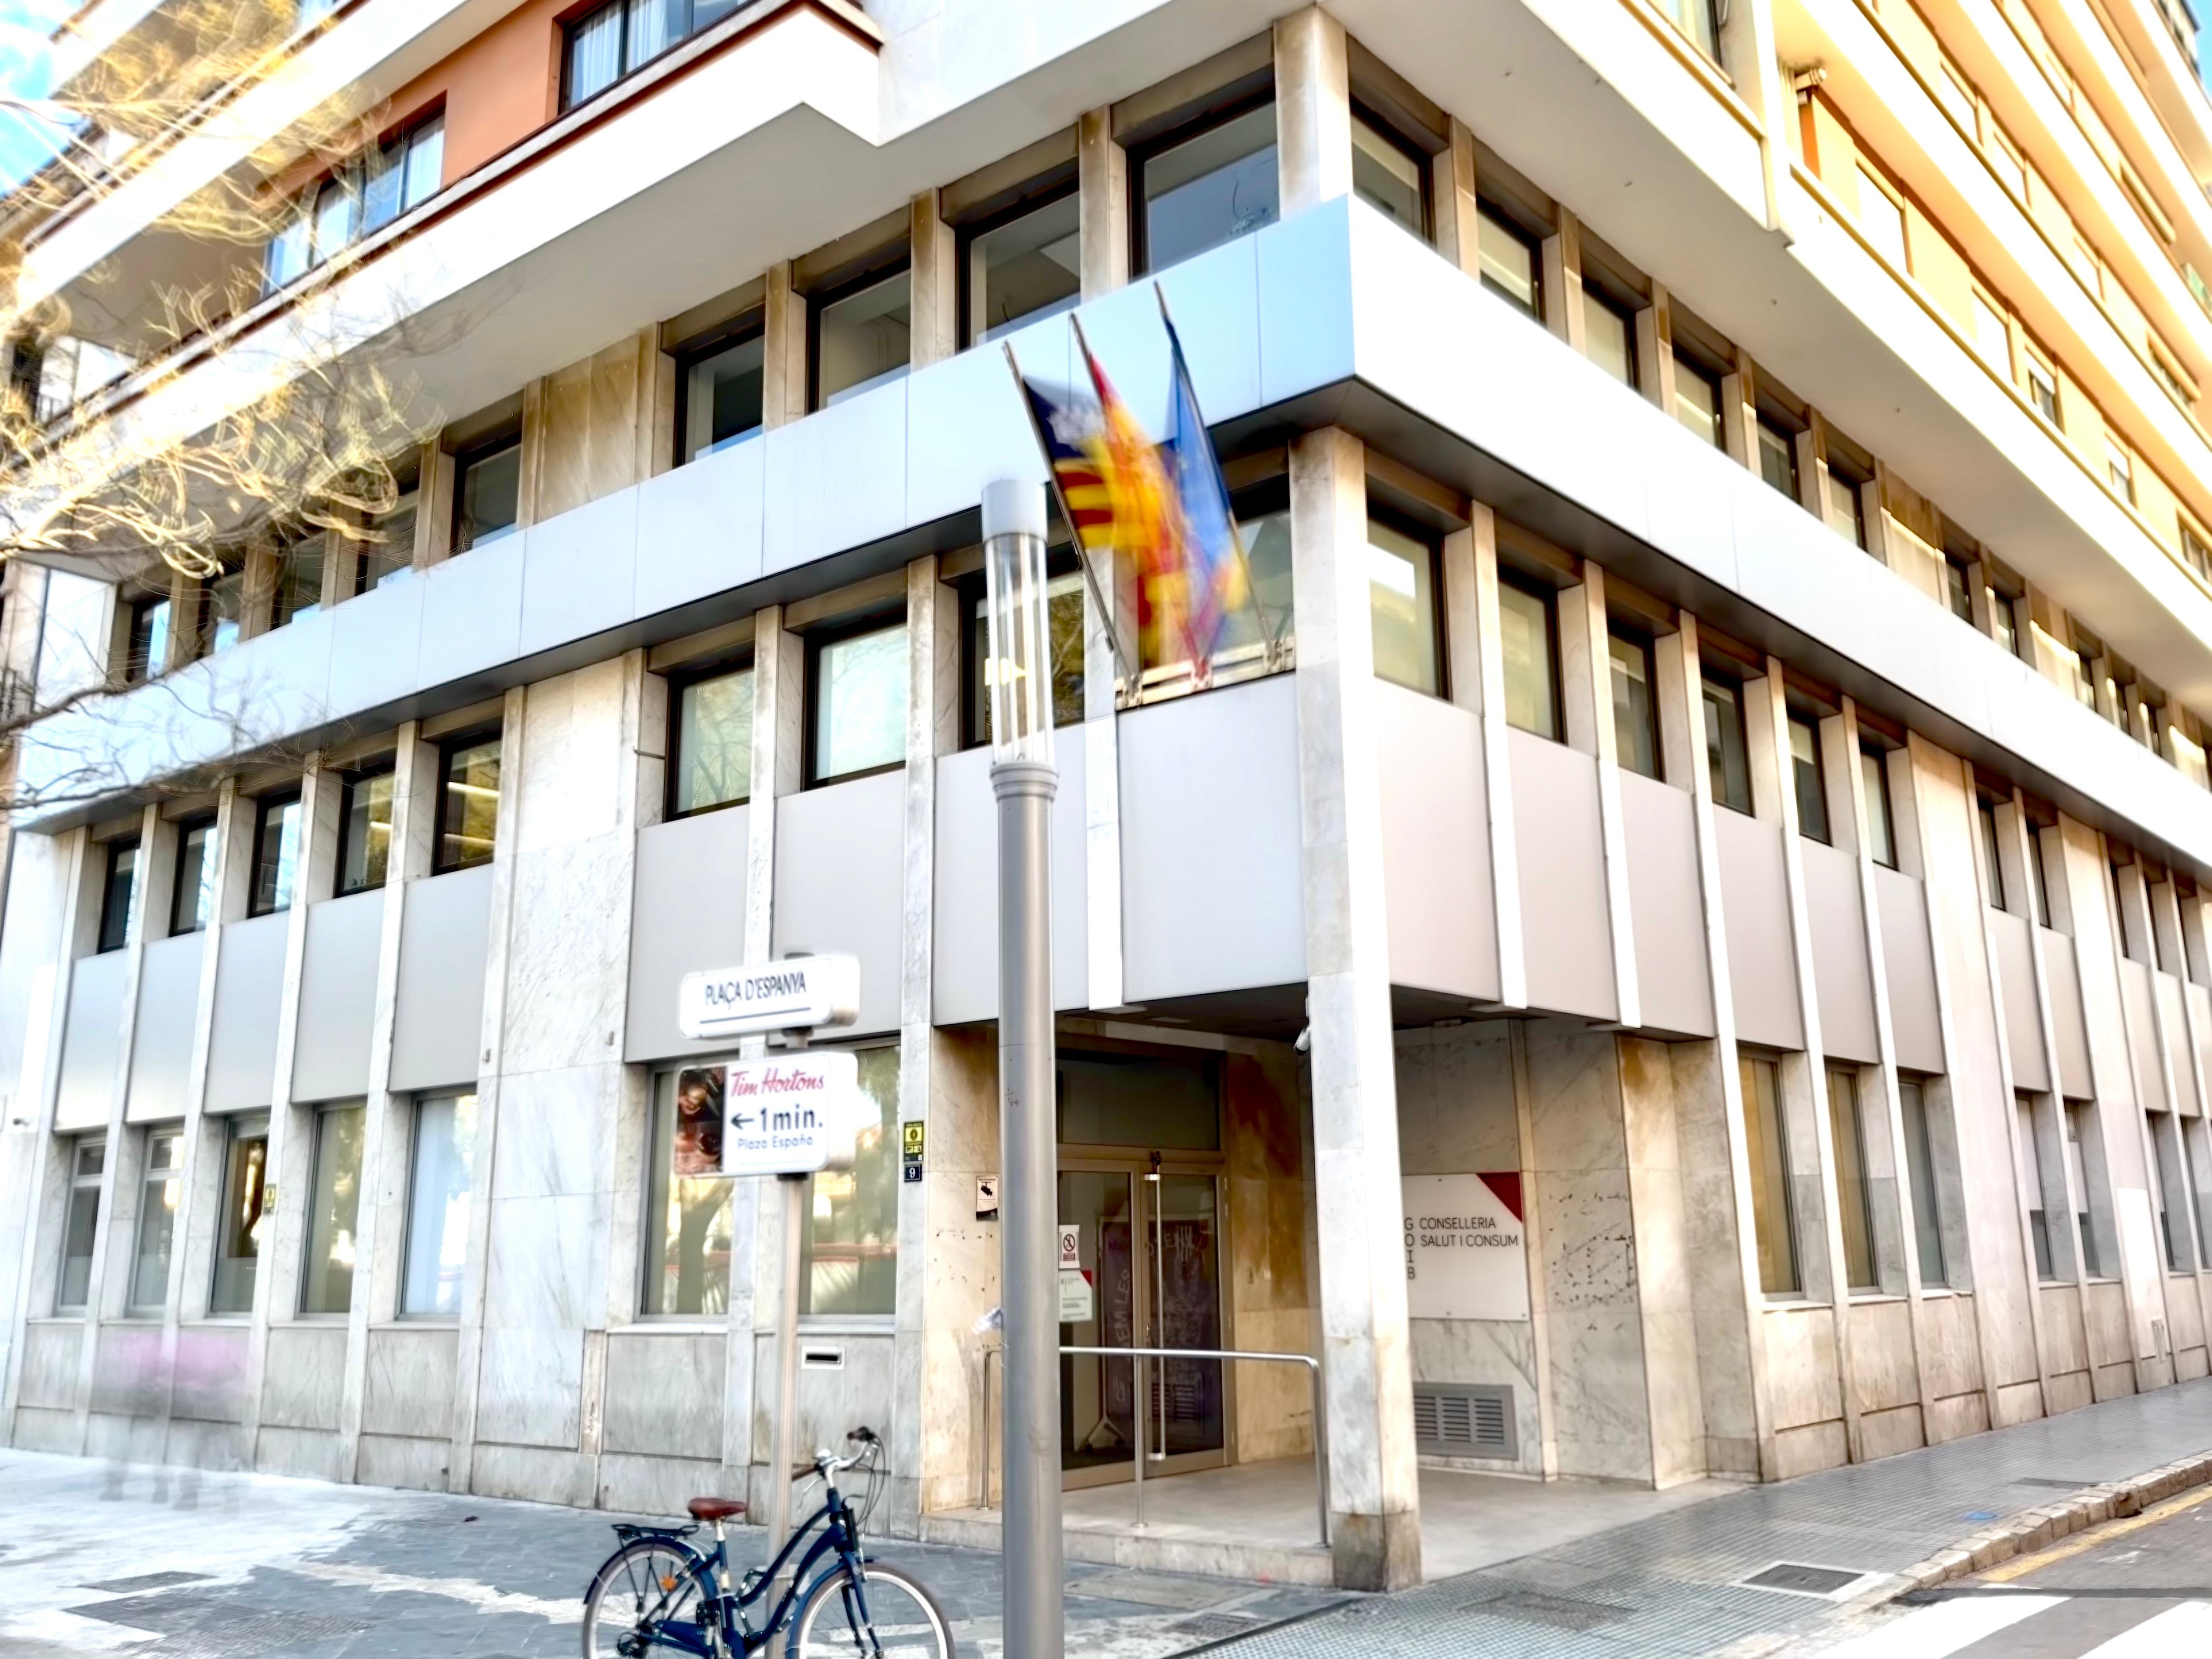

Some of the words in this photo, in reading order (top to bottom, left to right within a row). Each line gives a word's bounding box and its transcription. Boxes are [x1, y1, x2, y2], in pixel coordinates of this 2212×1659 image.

[705, 981, 743, 1010] PLAÇA
[746, 971, 807, 1001] D'ESPANYA
[730, 1070, 758, 1098] Tim
[761, 1067, 825, 1094] Hortons
[772, 1134, 813, 1150] España
[909, 1168, 916, 1178] 9
[1419, 1218, 1496, 1230] CONSELLERIA
[1420, 1235, 1455, 1247] SALUT
[1459, 1236, 1463, 1246] I
[1466, 1235, 1518, 1246] CONSUM
